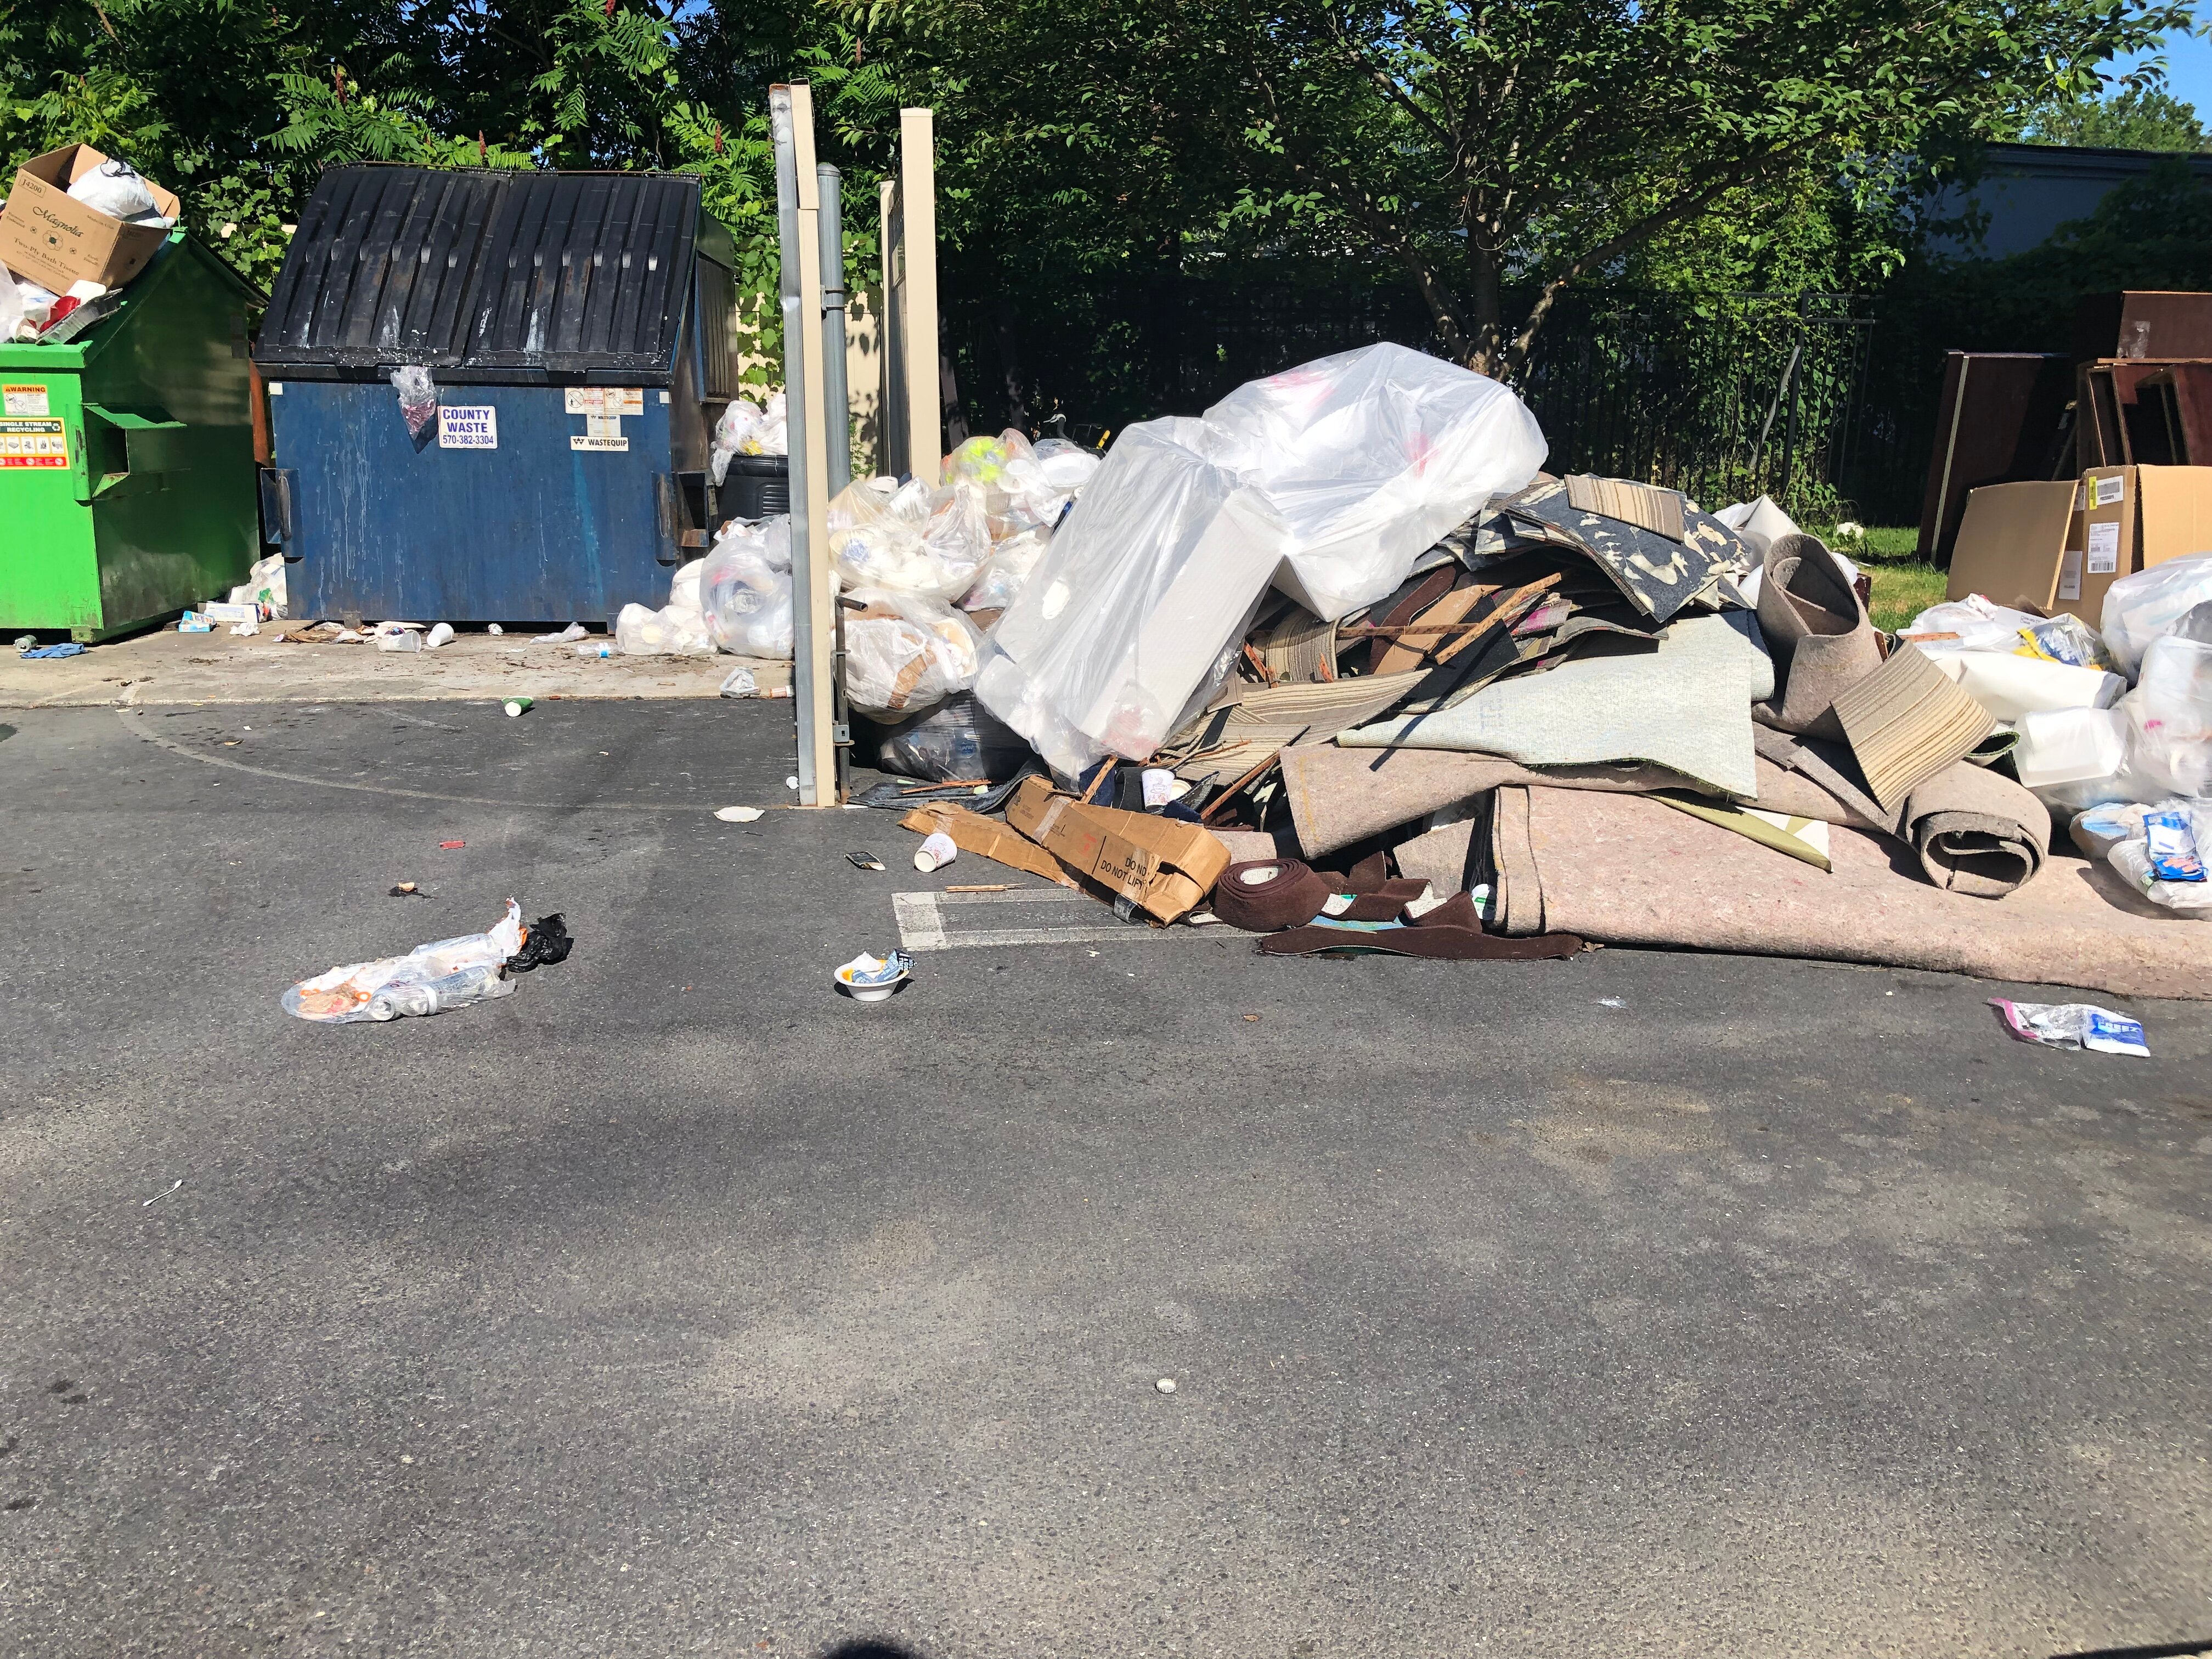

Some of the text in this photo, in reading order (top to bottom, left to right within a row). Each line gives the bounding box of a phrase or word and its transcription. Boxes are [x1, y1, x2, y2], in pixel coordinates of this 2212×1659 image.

[21, 178, 42, 194] J4200
[32, 206, 84, 238] Magnolia
[14, 237, 40, 256] Two-Ply
[42, 252, 57, 264] Bath
[443, 409, 490, 420] COUNTY
[447, 422, 488, 433] WASTE
[443, 435, 494, 444] 570-382-3304
[1101, 860, 1111, 872] DO
[1111, 866, 1128, 881] NOT
[1125, 857, 1147, 877] DO NO
